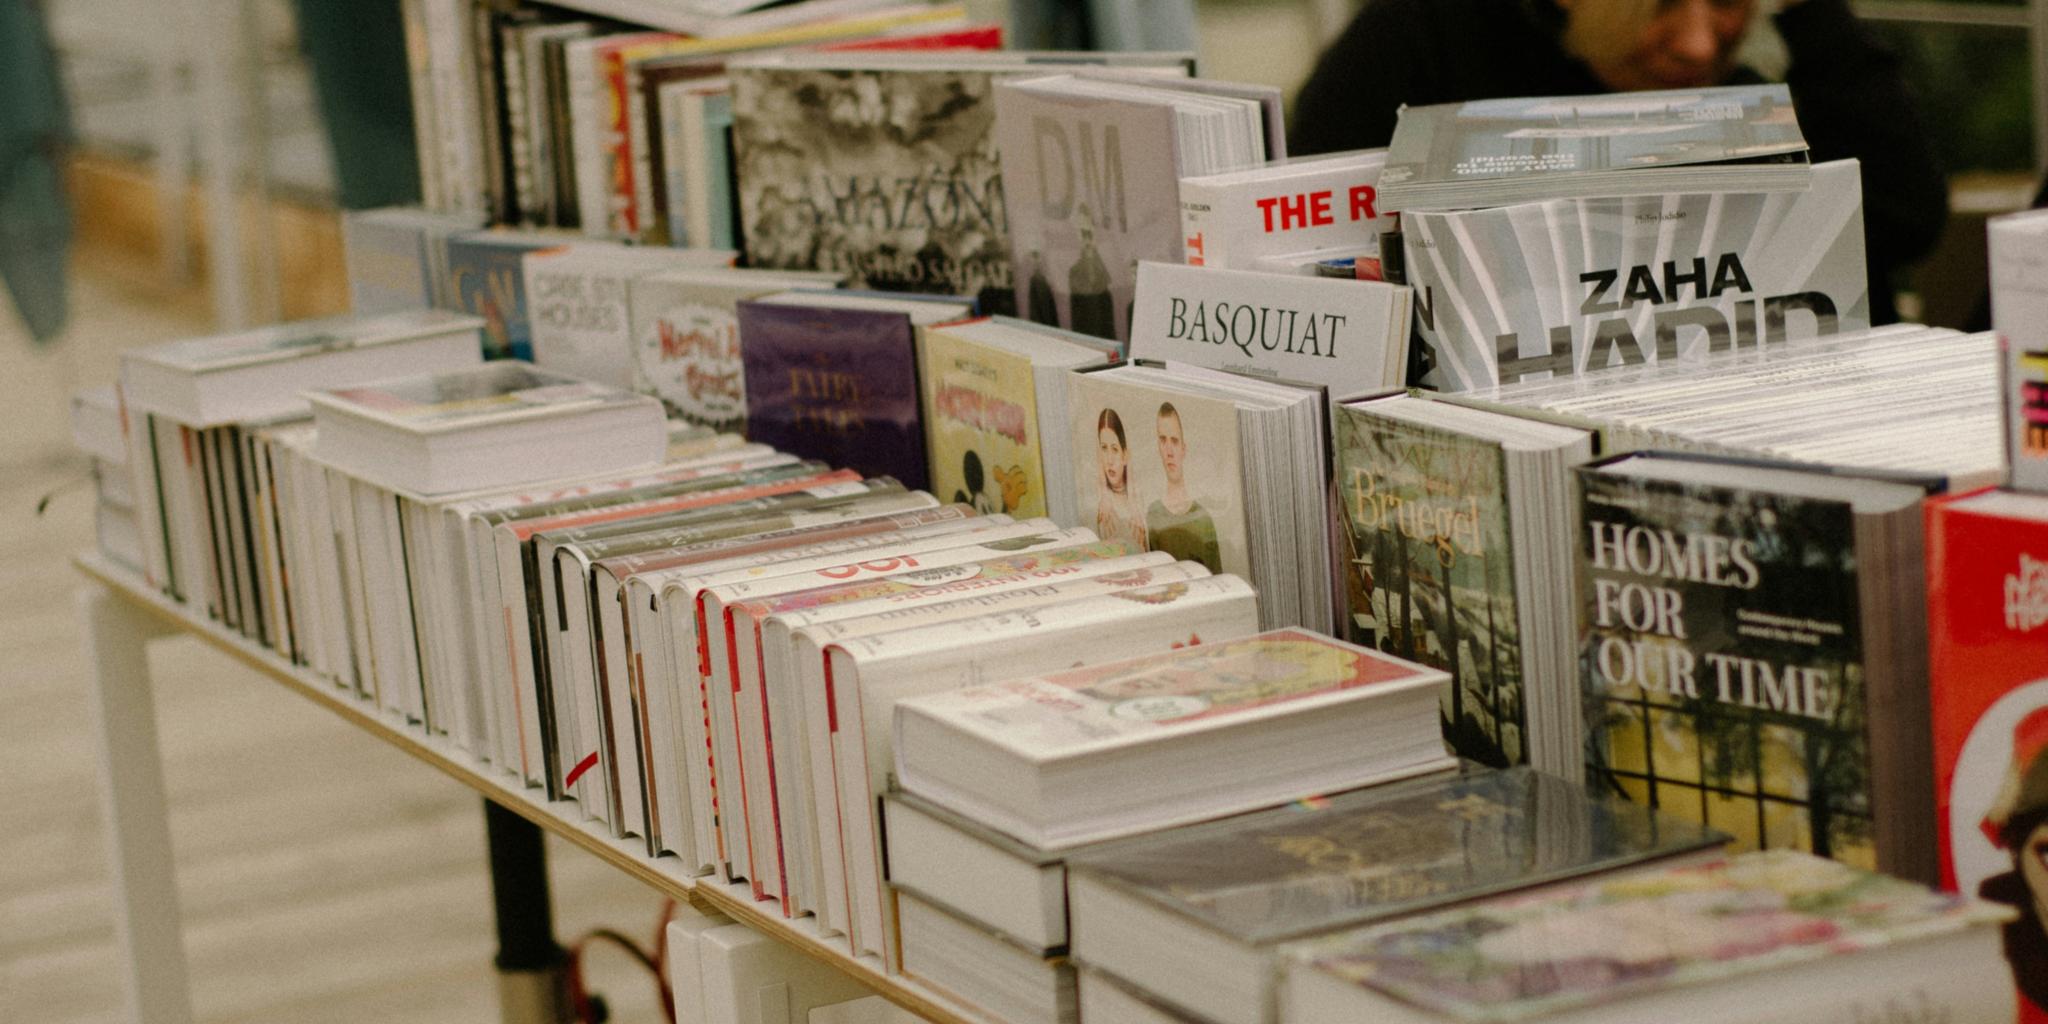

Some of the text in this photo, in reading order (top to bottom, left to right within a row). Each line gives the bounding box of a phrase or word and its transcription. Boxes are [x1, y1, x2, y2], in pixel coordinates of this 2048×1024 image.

[1031, 114, 1128, 233] DM
[1256, 190, 1334, 233] THE
[1580, 252, 1753, 315] ZAHA
[1167, 297, 1347, 358] BASQUIAT
[1495, 291, 1839, 386] HADID
[1354, 466, 1484, 569] Bruegel
[1589, 519, 1760, 590] HOMES
[1594, 577, 1688, 640] FOR
[1598, 637, 1833, 721] OUR TIME
